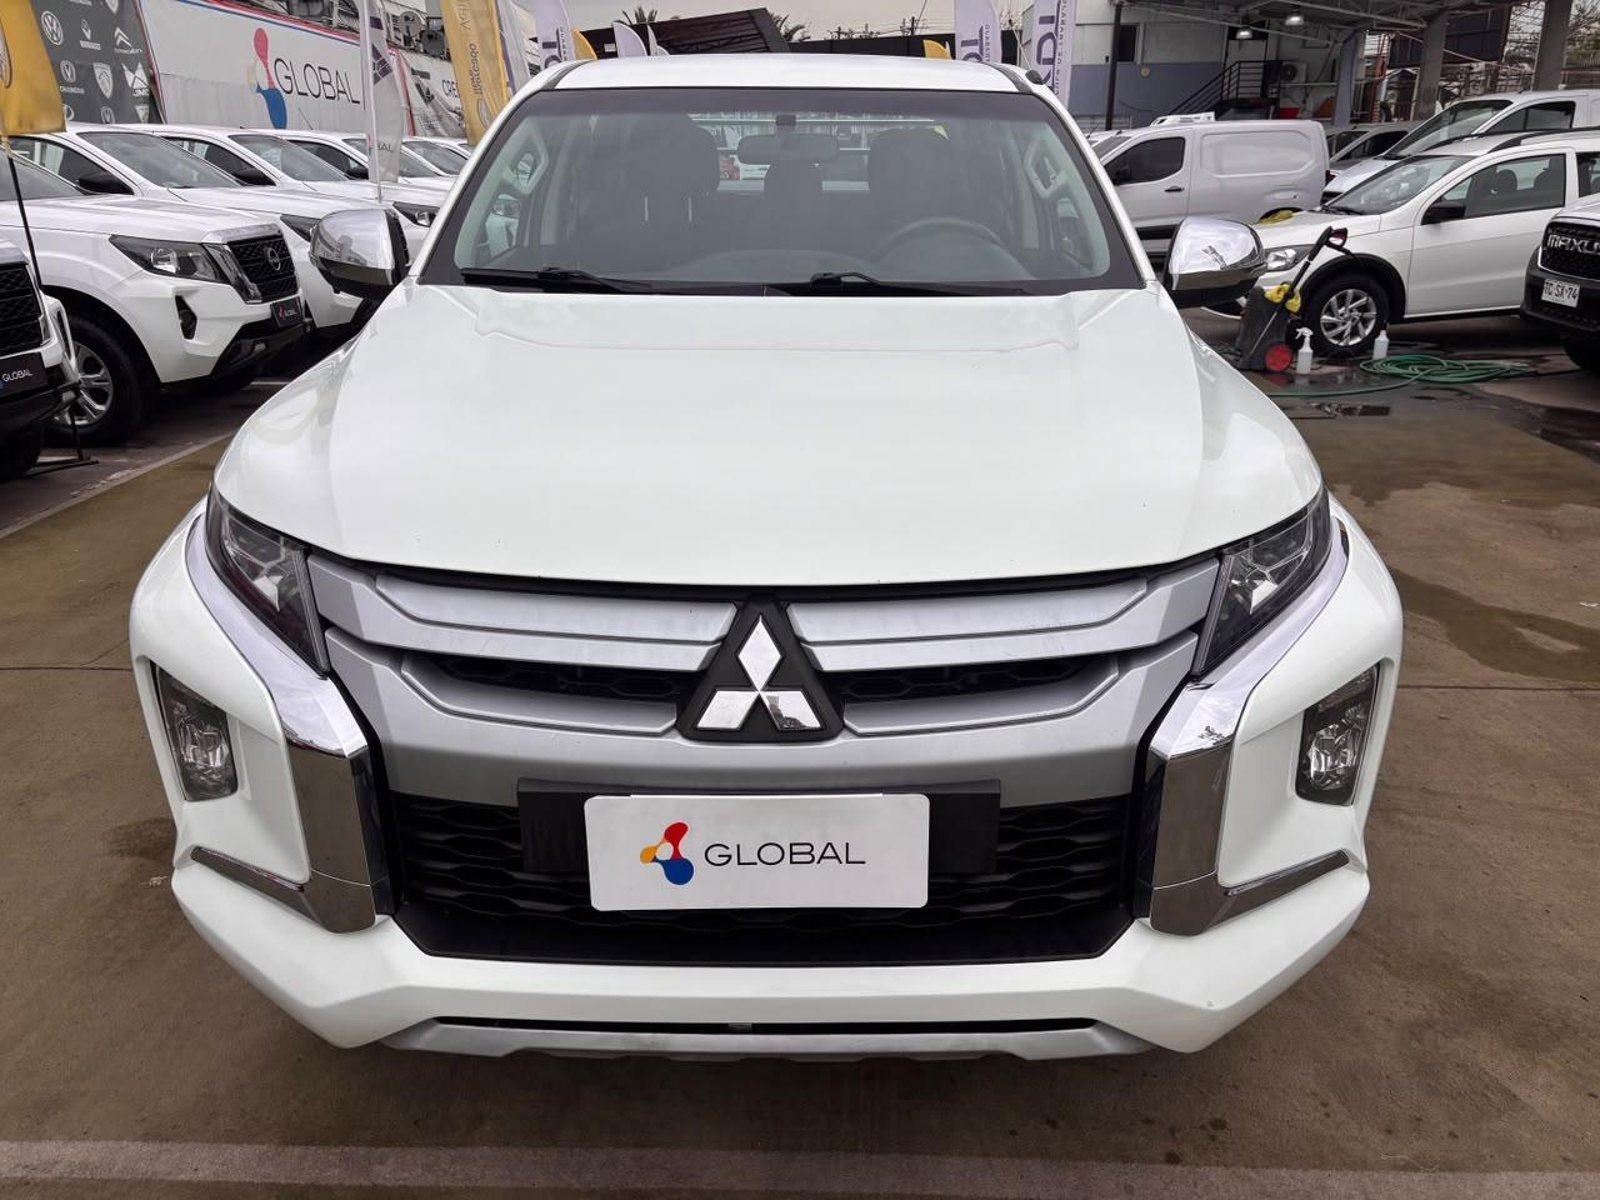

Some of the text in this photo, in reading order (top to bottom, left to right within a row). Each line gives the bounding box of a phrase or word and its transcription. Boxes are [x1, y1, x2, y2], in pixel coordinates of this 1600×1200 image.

[273, 58, 361, 104] GLOBAL
[441, 79, 460, 99] CRE
[2, 369, 33, 382] GLOBAL
[704, 842, 866, 867] GLOBAL
